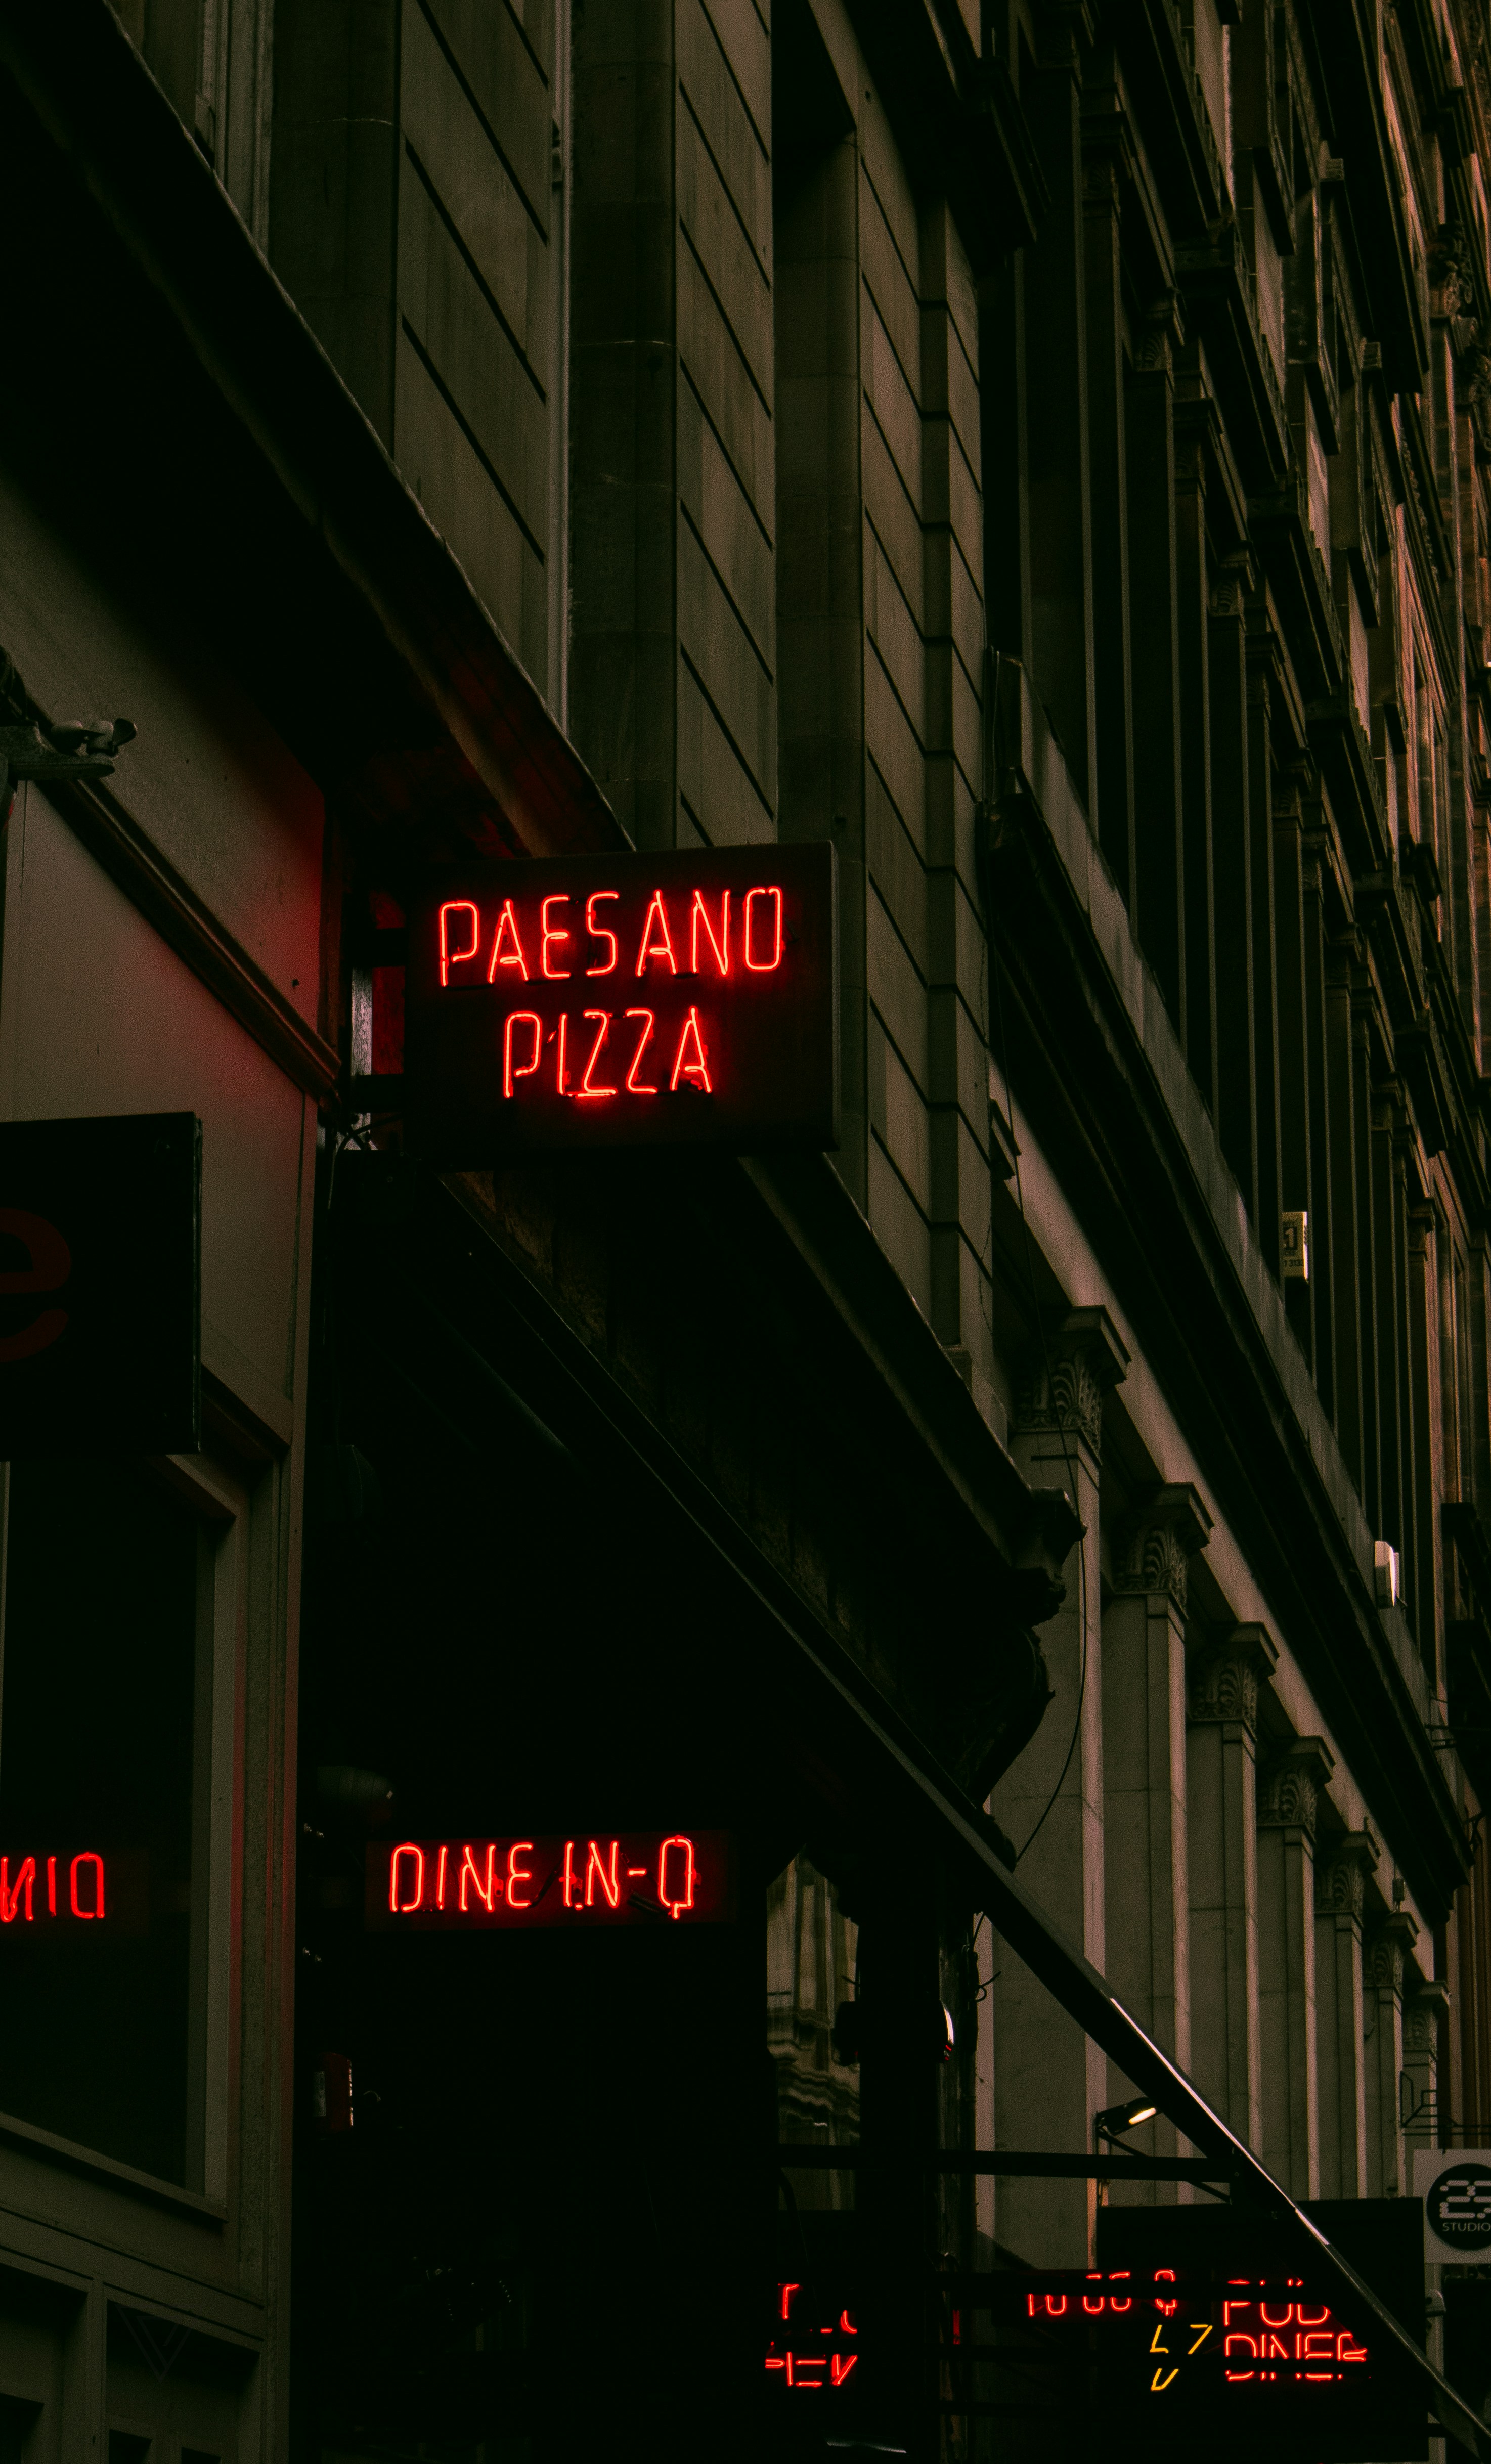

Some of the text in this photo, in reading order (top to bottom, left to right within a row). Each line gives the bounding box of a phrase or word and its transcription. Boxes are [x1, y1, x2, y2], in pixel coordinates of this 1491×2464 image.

[438, 886, 786, 987] PAESANO
[503, 1005, 712, 1098] PIZZA
[389, 1835, 697, 1919] DINE IN-Q
[1442, 2222, 1491, 2232] STUDIO
